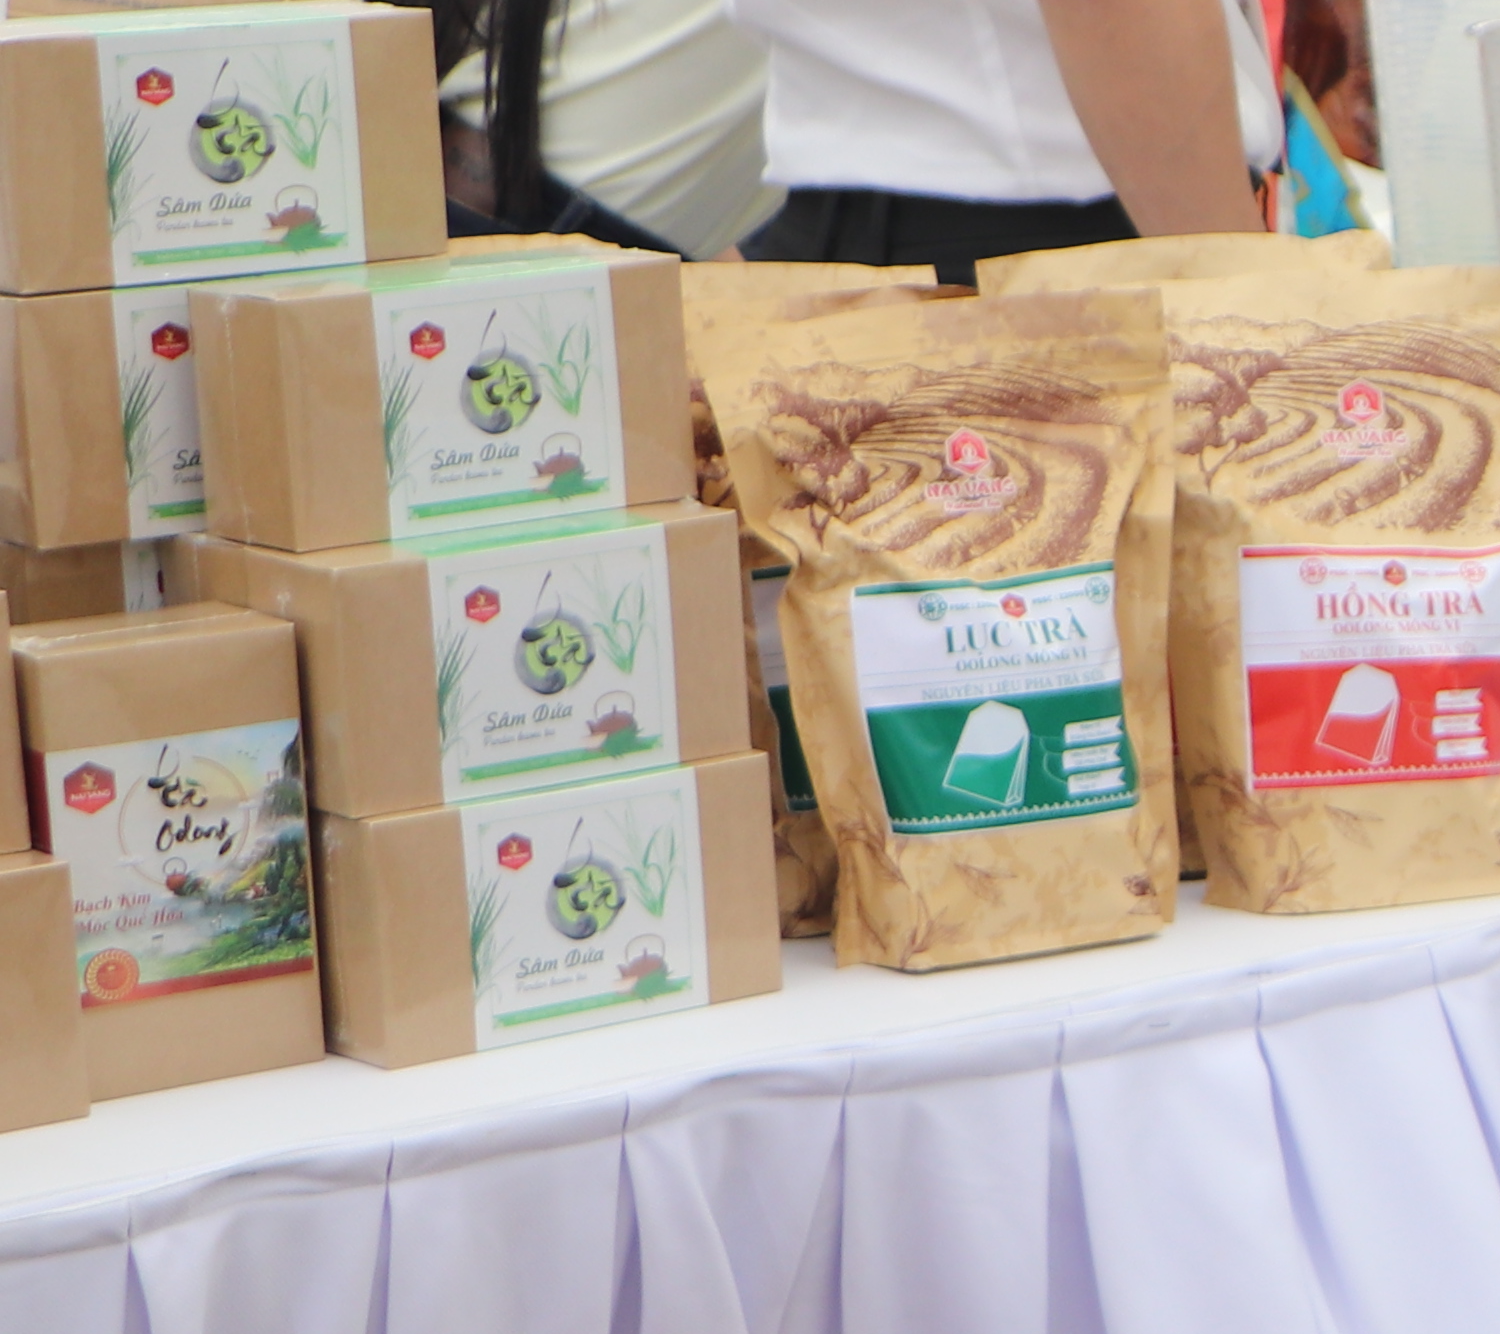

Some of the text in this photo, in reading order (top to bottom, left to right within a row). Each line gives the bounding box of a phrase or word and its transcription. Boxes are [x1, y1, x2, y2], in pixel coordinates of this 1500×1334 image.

[156, 196, 201, 217] Sâm
[172, 448, 203, 471] Sâ
[430, 447, 474, 471] Sâm
[1420, 582, 1484, 615] TRÀ
[1019, 608, 1088, 645] TRÀ
[483, 712, 526, 733] Sâm
[516, 958, 558, 979] Sâm
